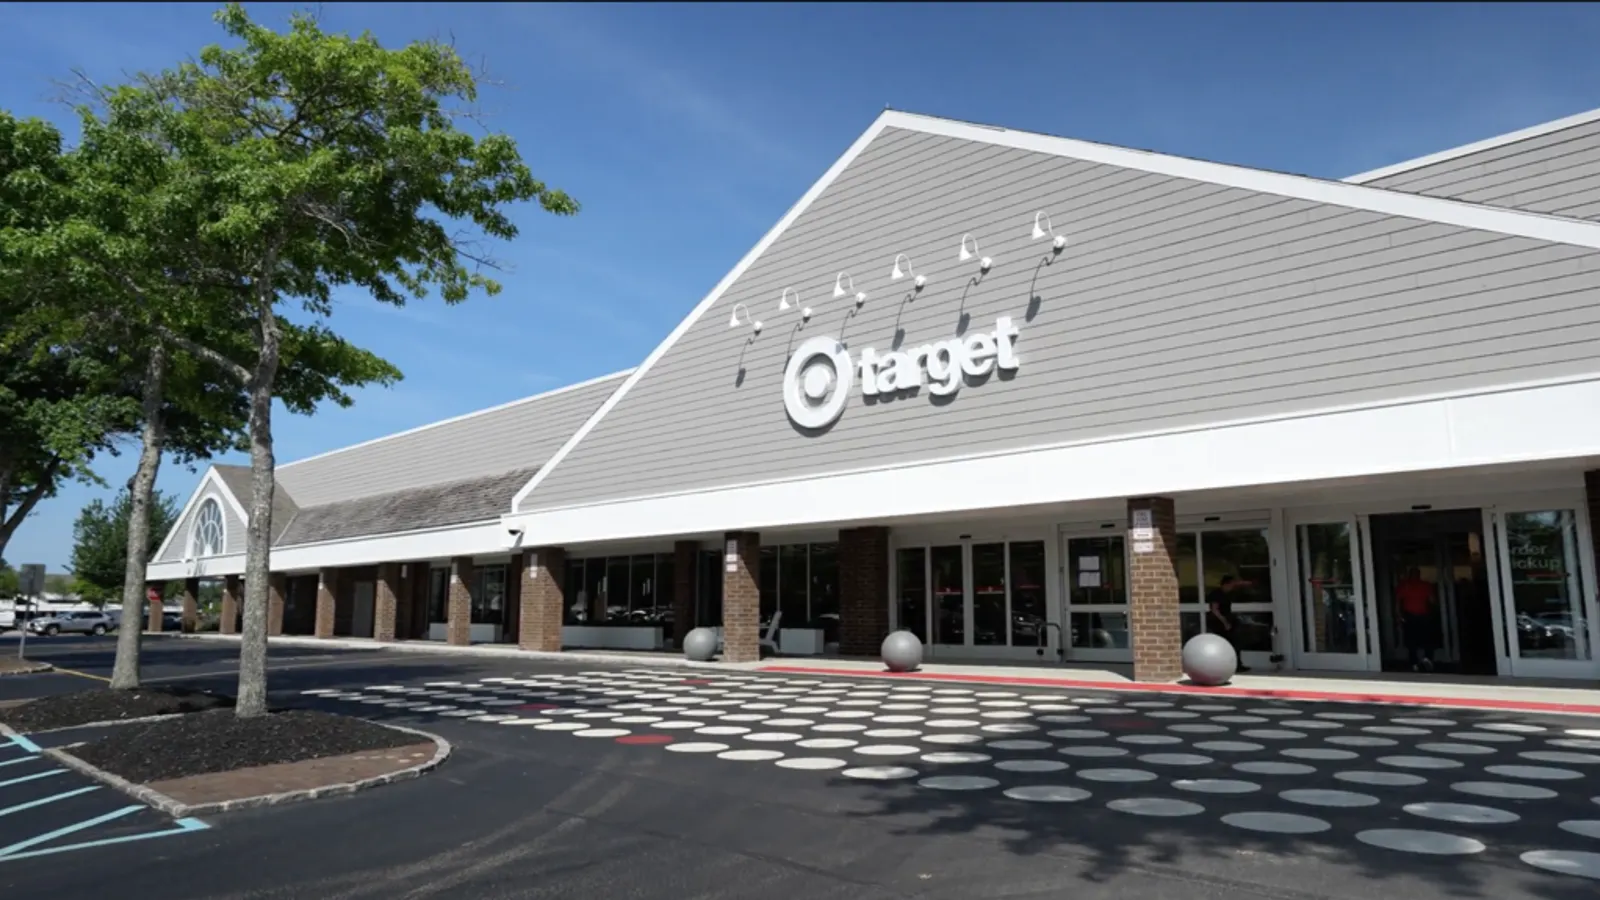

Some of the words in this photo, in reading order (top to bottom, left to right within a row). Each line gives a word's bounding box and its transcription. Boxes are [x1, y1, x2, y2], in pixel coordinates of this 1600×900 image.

[857, 315, 1019, 395] target
[1511, 541, 1548, 555] rder
[1511, 556, 1560, 571] ickup
